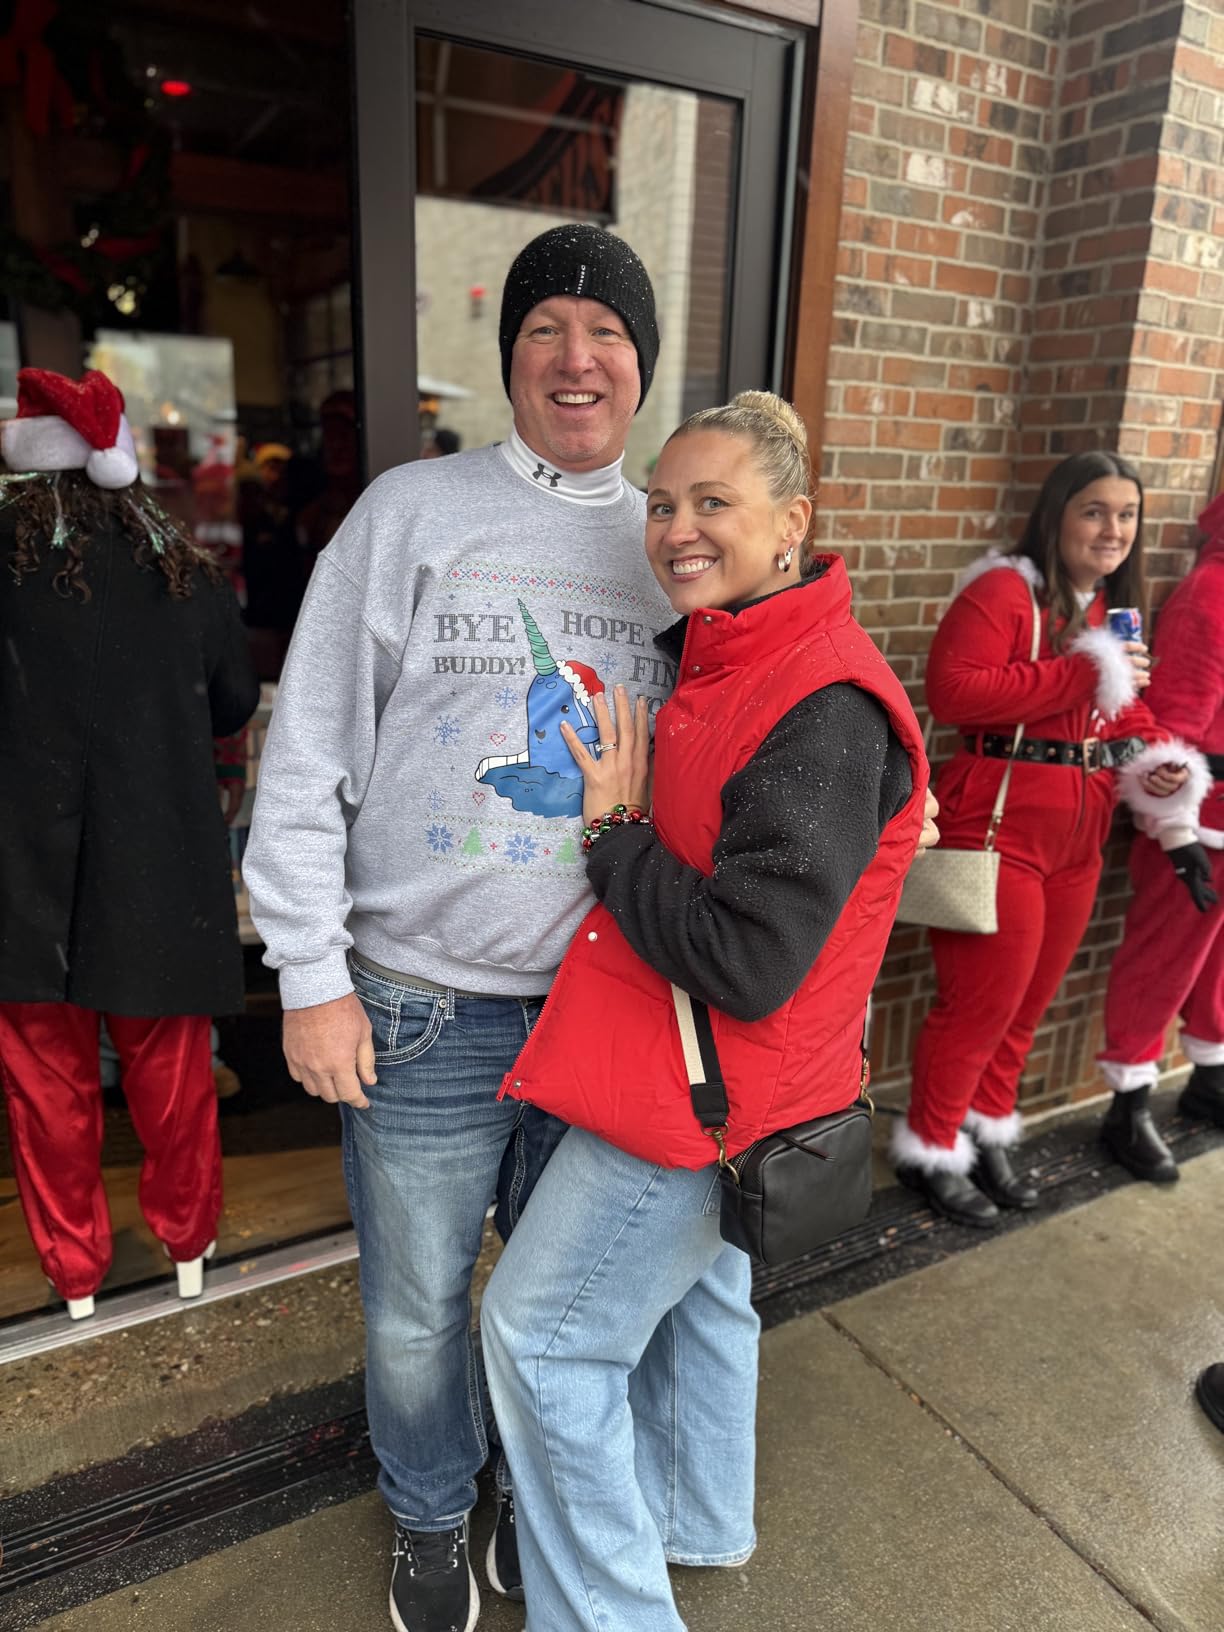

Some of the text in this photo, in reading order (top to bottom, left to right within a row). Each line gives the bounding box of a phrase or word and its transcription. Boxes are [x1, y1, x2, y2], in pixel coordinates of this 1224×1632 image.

[433, 613, 516, 643] BYE
[560, 609, 645, 647] HOPE
[432, 656, 526, 675] BUDDY!
